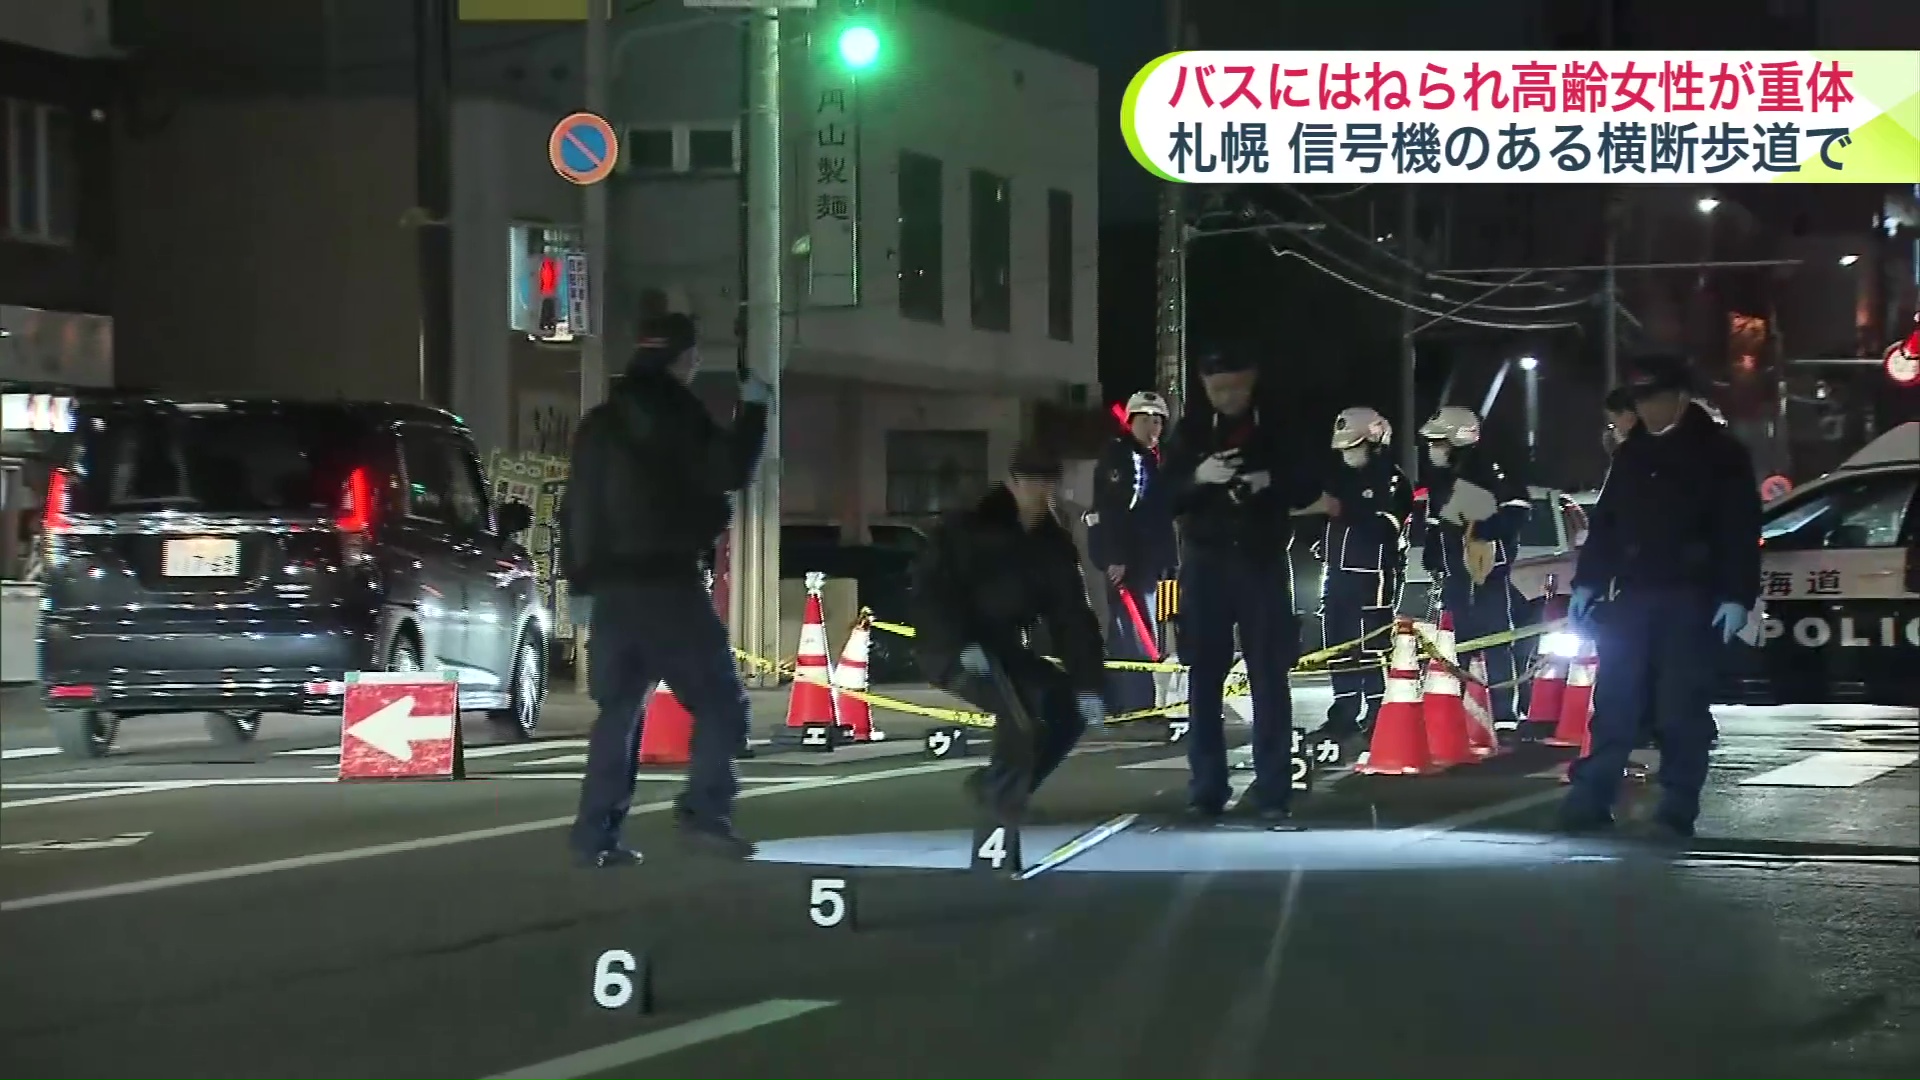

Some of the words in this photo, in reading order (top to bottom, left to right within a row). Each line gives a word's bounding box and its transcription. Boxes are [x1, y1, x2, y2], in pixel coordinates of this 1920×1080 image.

[1316, 740, 1340, 763] カ
[1290, 757, 1308, 789] 2
[978, 827, 1007, 869] 4
[810, 879, 845, 927] 5
[593, 949, 636, 1008] 6
